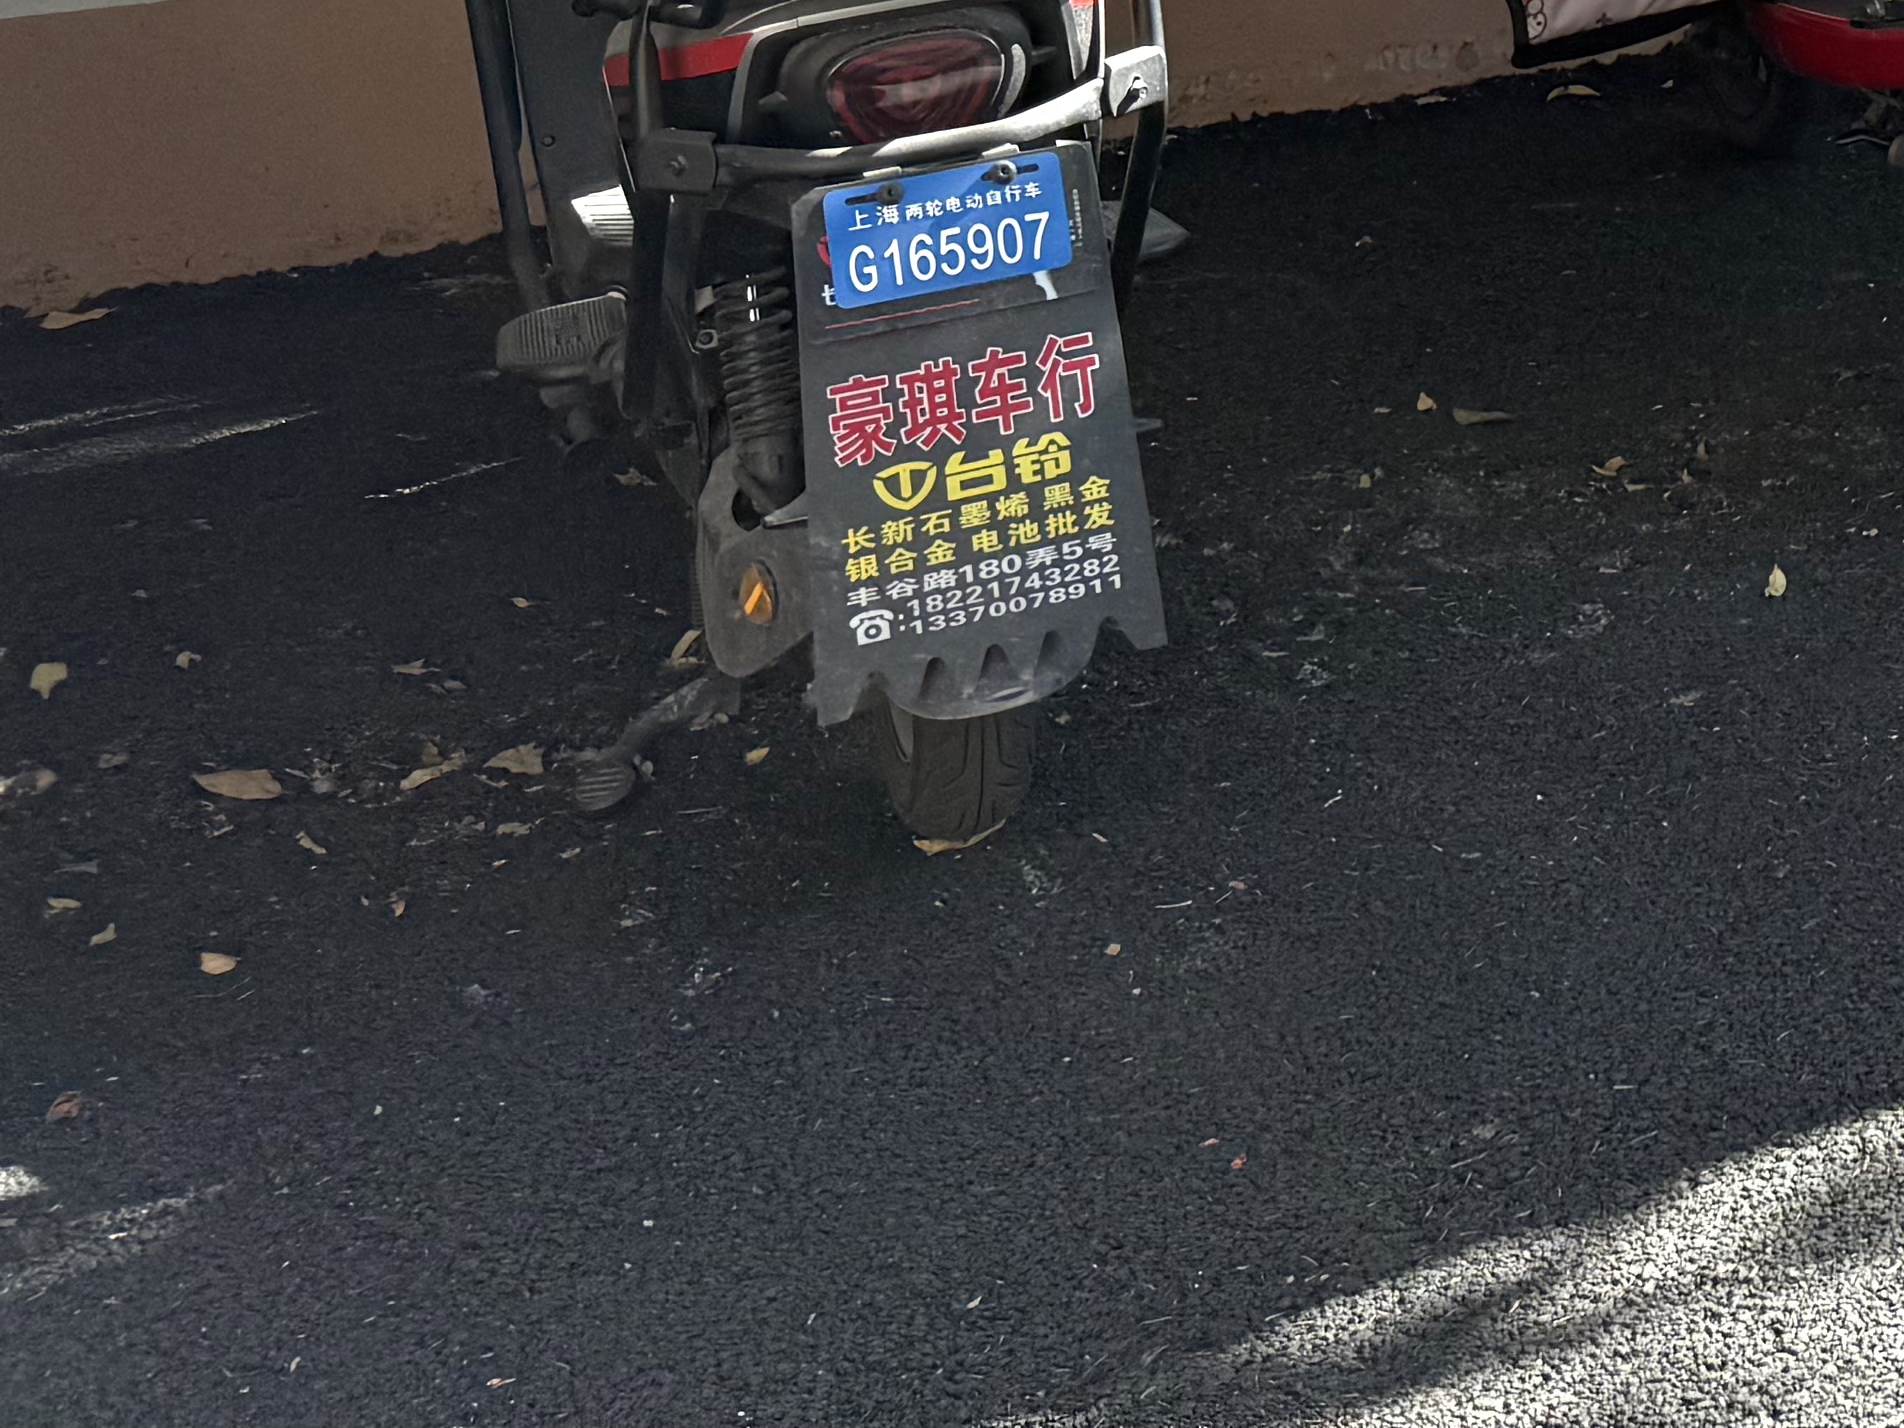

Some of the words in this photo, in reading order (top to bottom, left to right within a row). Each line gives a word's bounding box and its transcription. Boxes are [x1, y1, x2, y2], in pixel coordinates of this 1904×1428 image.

[848, 211, 1050, 293] G165907
[826, 331, 1100, 467] 豪琪车行
[841, 490, 1030, 555] 长新石墨烯
[1043, 475, 1111, 511] 黑金
[844, 538, 957, 584] 银合金
[971, 502, 1116, 555] 电池批发
[846, 532, 1117, 608] 丰谷路180弄5号
